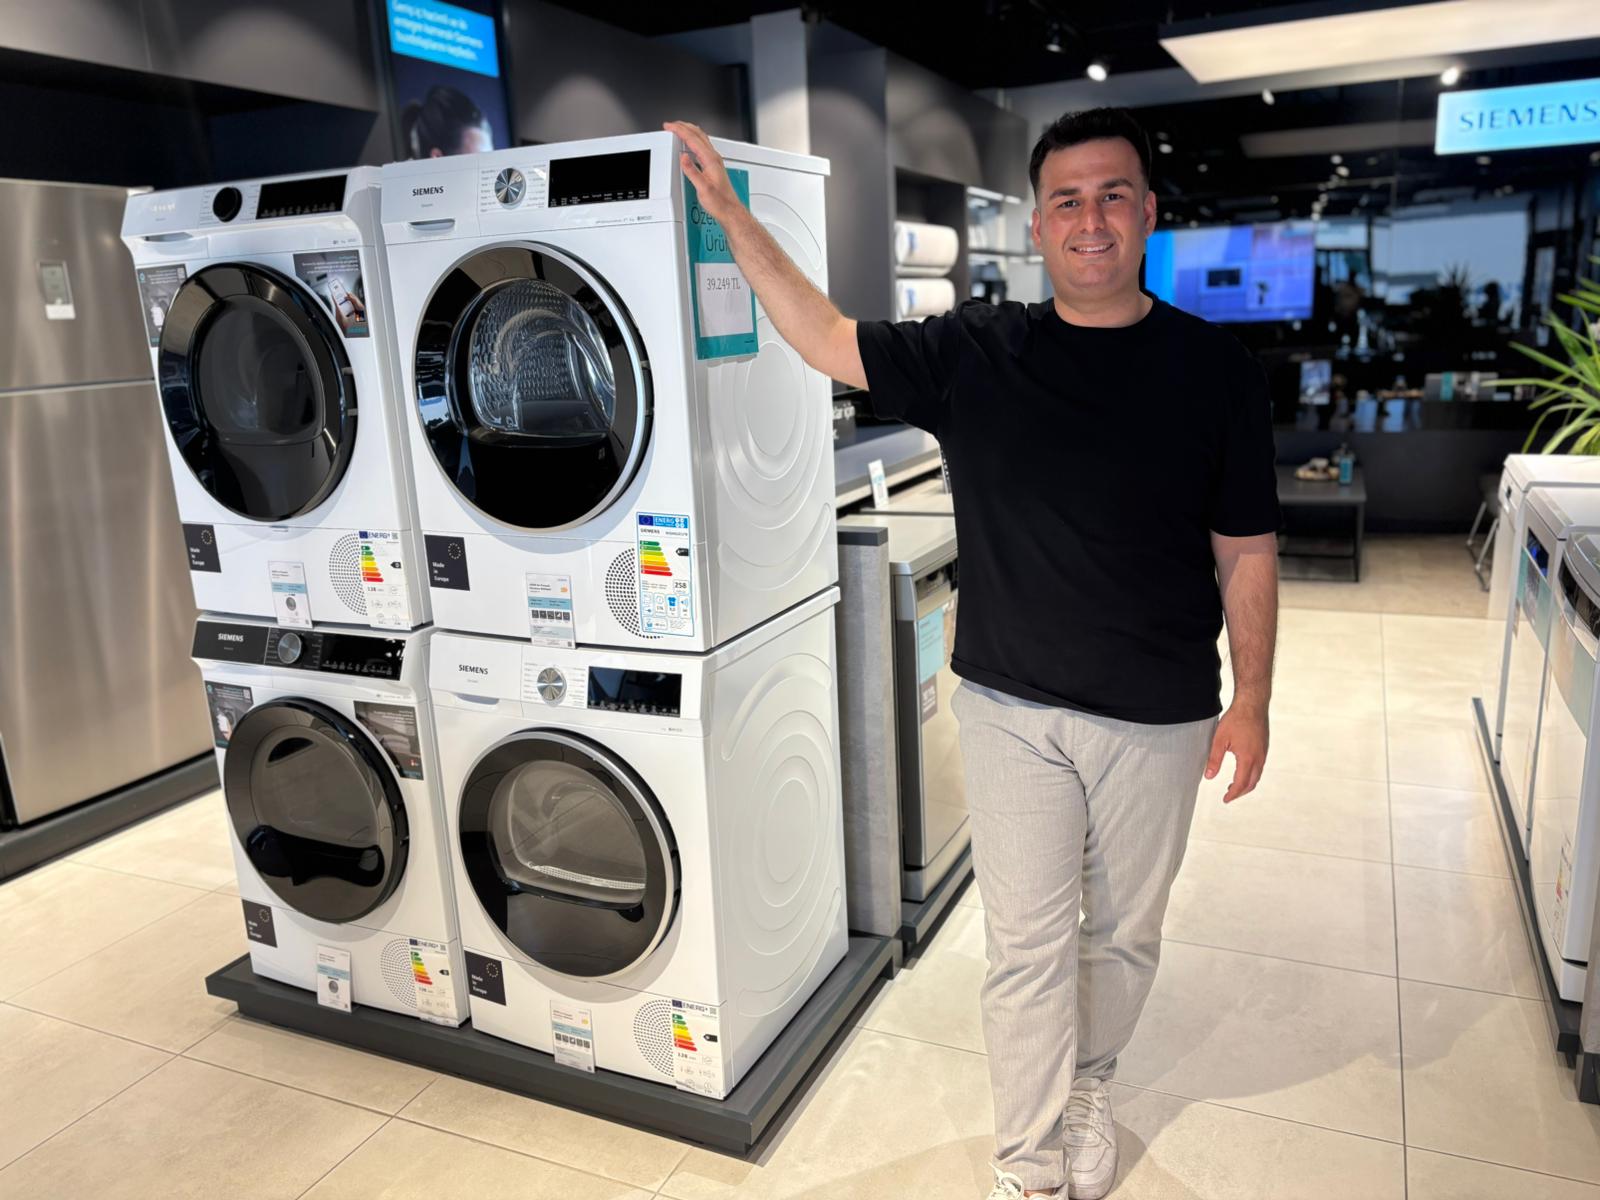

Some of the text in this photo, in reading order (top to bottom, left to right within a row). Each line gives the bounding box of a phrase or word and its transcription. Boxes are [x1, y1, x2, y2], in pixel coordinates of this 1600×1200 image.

[1458, 100, 1599, 132] SIEMENS
[412, 186, 444, 196] SIEMENS
[706, 277, 741, 291] 39.249 TL
[217, 633, 244, 642] SIEMENS
[458, 664, 489, 675] SIEMENS
